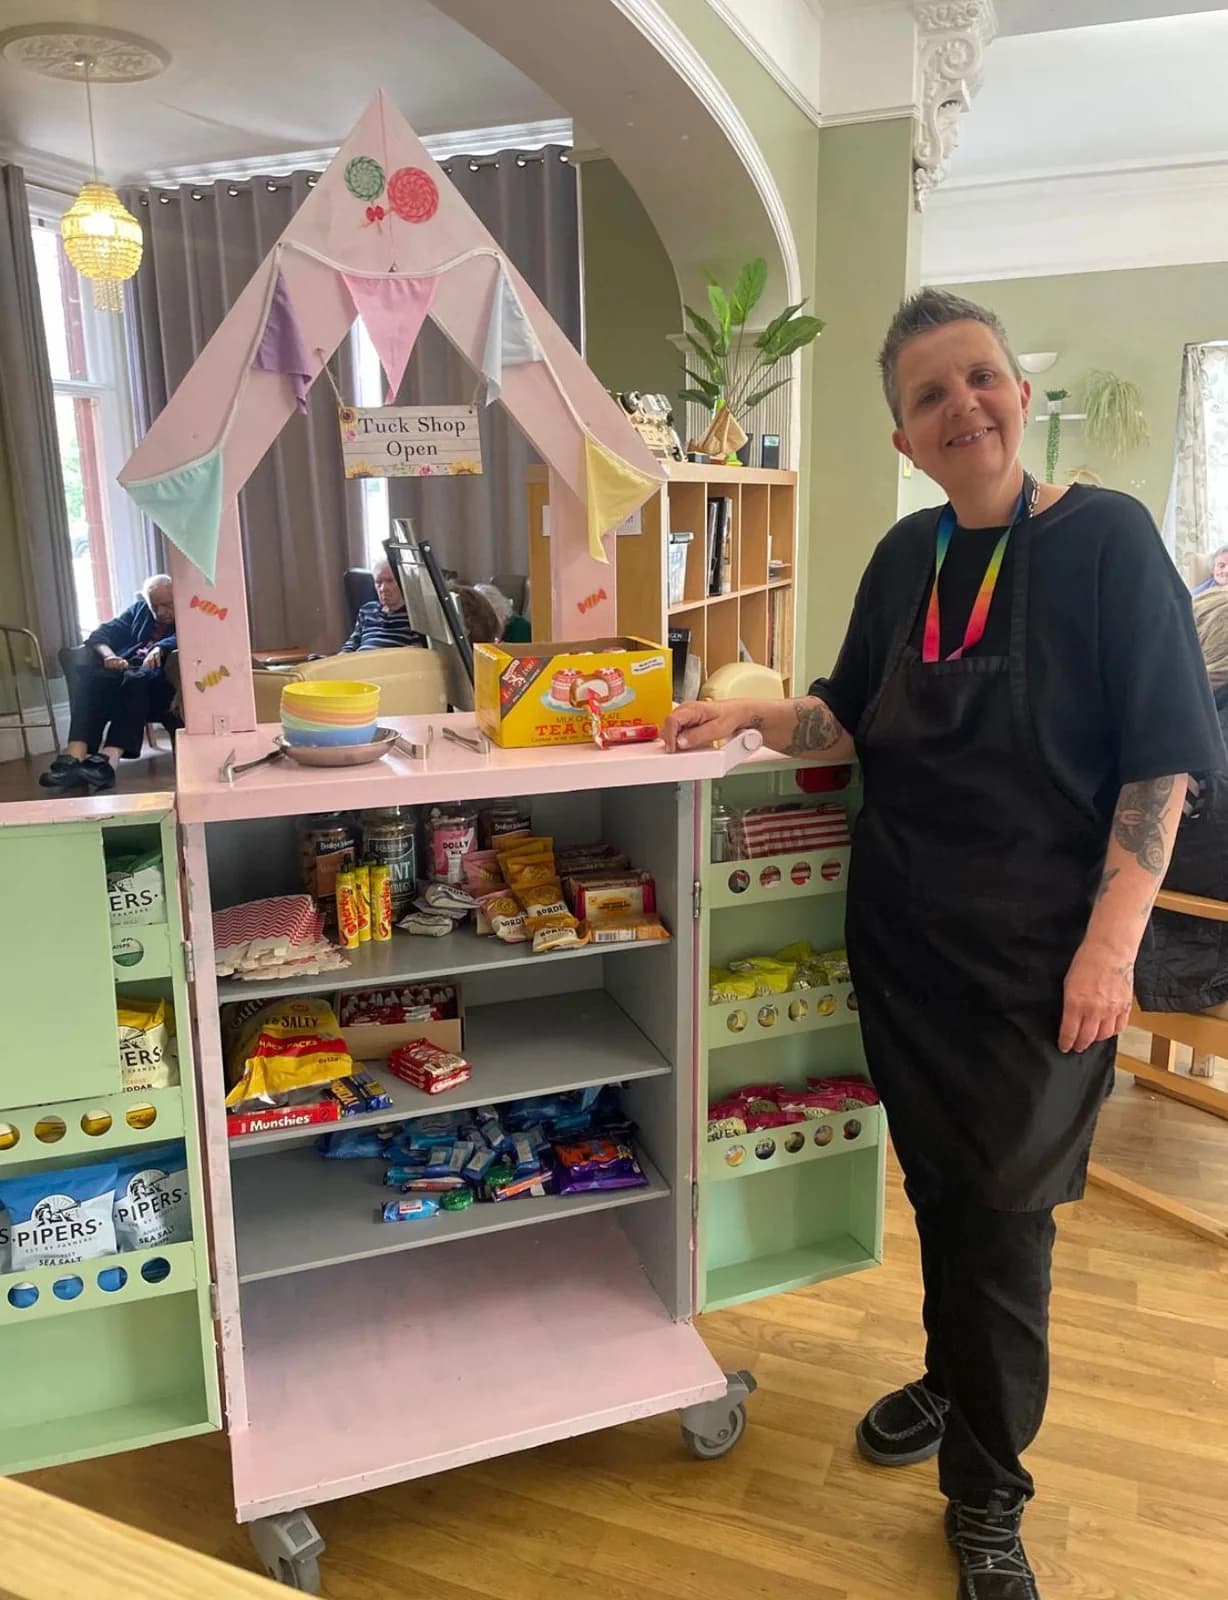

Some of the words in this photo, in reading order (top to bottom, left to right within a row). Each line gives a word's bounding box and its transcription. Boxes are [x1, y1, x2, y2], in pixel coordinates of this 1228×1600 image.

[358, 417, 409, 434] Tuck
[418, 416, 465, 437] Shop
[386, 440, 438, 462] Open
[536, 722, 576, 736] TEA
[582, 718, 643, 736] CKES
[442, 840, 469, 849] DOLLY
[109, 889, 153, 911] ERS
[281, 1015, 319, 1029] SALTY
[121, 1046, 162, 1067] ERS
[249, 1114, 311, 1132] Munchies
[118, 1188, 183, 1223] PIPERS
[17, 1219, 98, 1248] PIPERS
[138, 1235, 157, 1244] SEA
[157, 1225, 176, 1240] SALT
[39, 1258, 57, 1267] SEA
[60, 1256, 82, 1265] SALT
